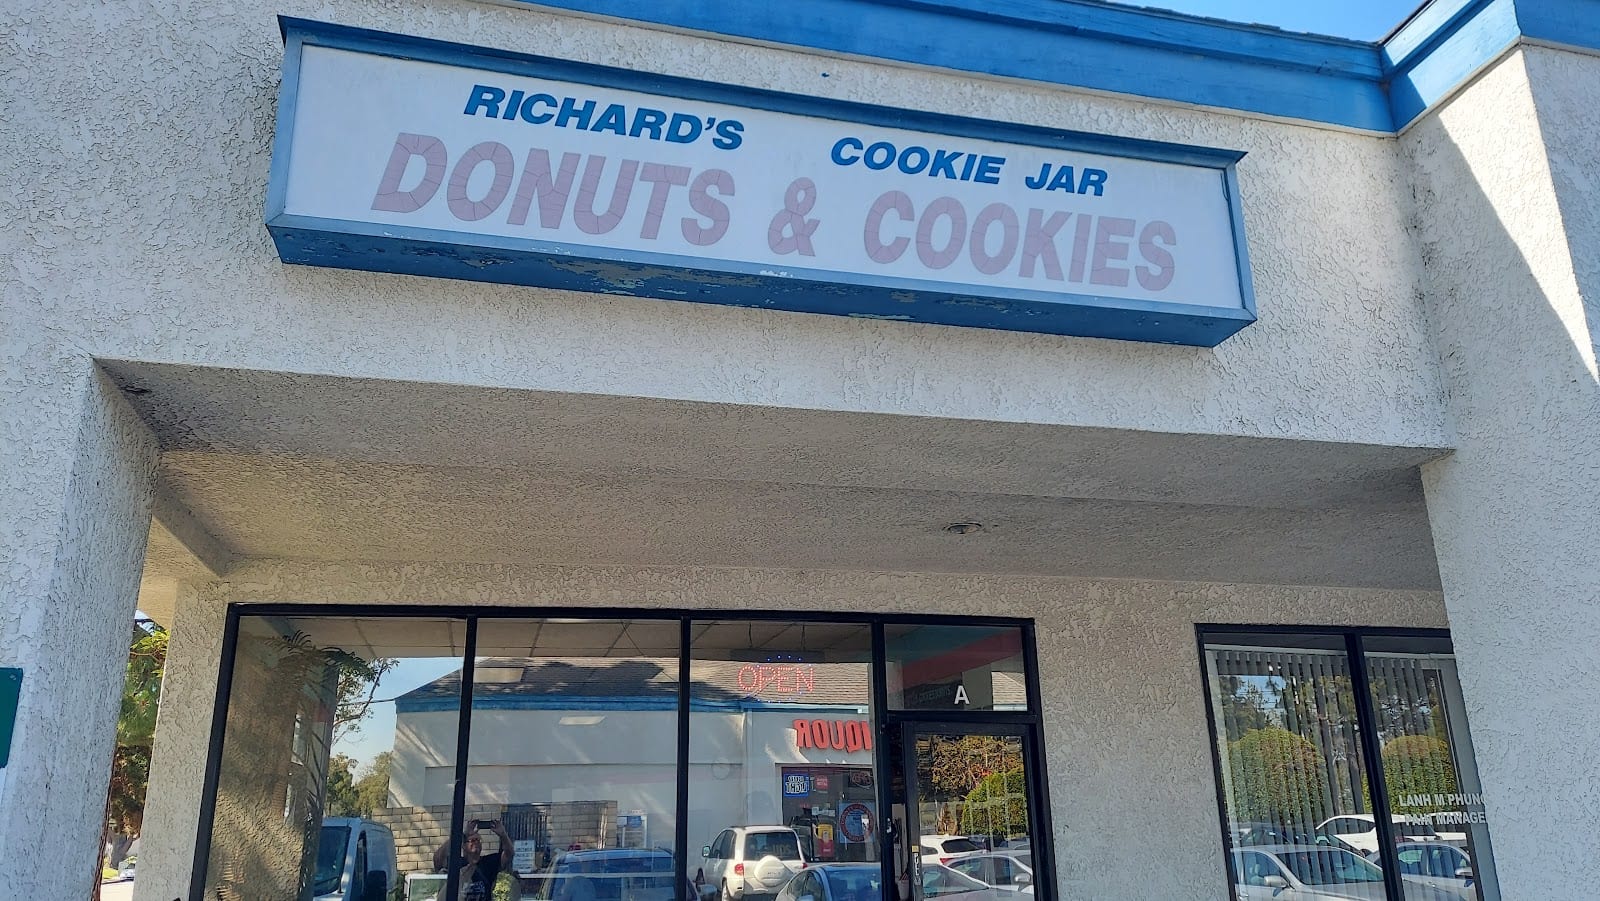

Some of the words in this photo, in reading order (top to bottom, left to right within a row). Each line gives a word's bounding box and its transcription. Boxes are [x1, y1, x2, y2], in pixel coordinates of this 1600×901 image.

[463, 84, 745, 150] RICHARD'S
[830, 136, 1007, 185] COOKIE
[1025, 162, 1109, 197] JAR
[370, 132, 736, 247] DONUTS
[767, 176, 821, 257] &
[863, 189, 1177, 292] COOKIES
[737, 665, 814, 693] OPEN
[954, 685, 970, 705] A
[1398, 794, 1431, 807] LANH
[1405, 813, 1433, 826] PAIN
